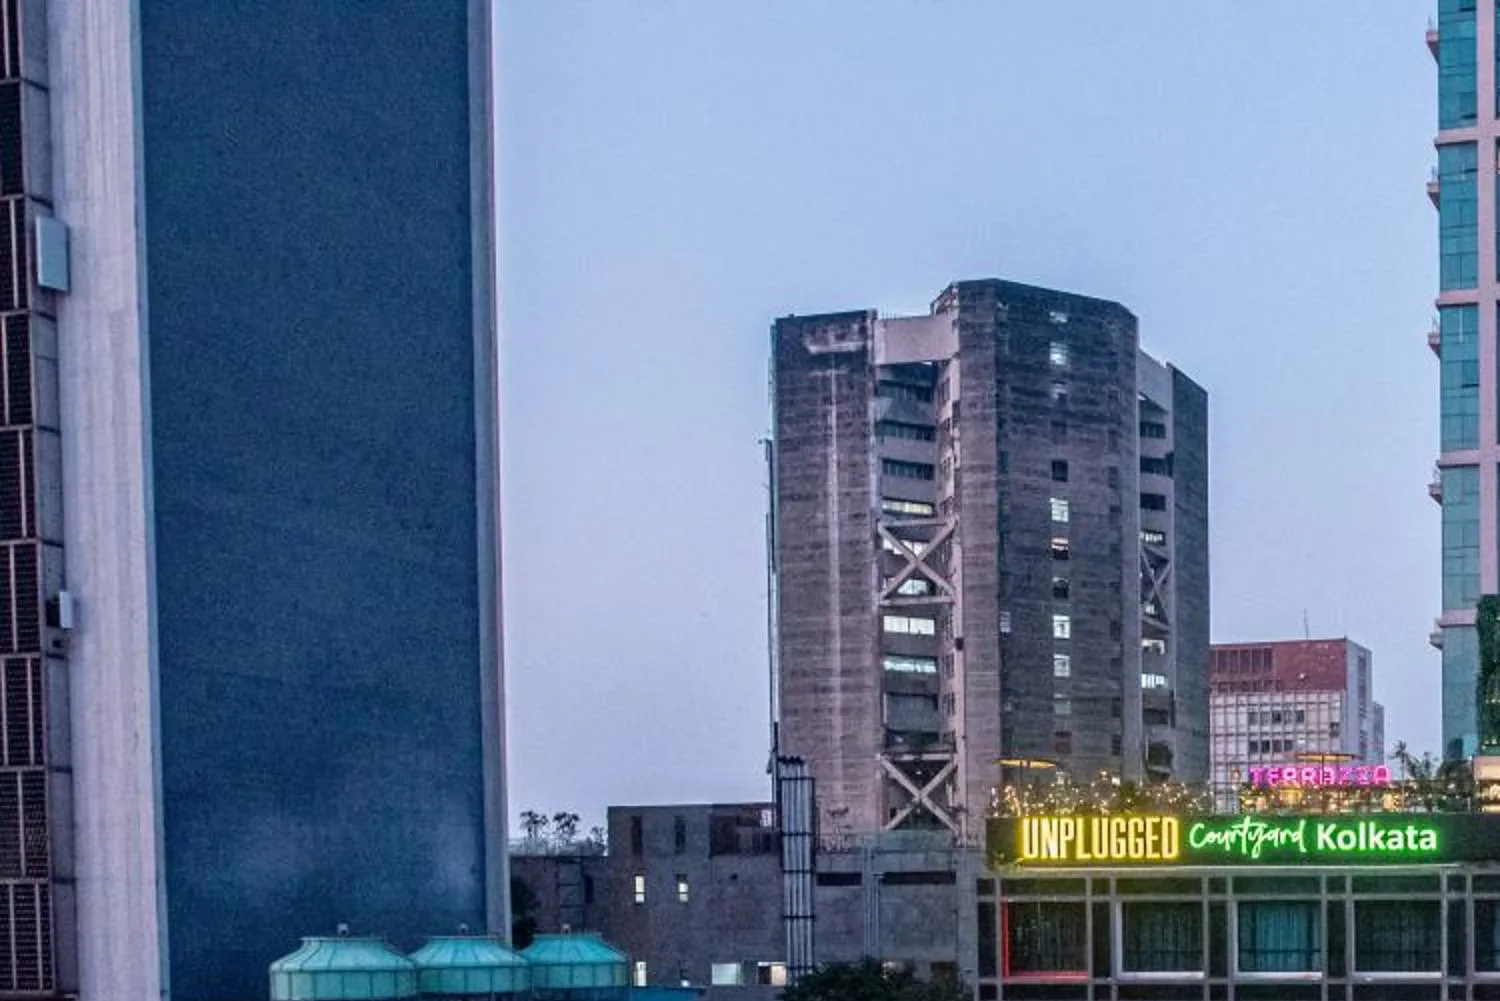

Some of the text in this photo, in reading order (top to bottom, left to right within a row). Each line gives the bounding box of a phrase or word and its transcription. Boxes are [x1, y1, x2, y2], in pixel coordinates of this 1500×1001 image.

[1022, 815, 1437, 859] UNPLUGGED Courtyard Kolkata
